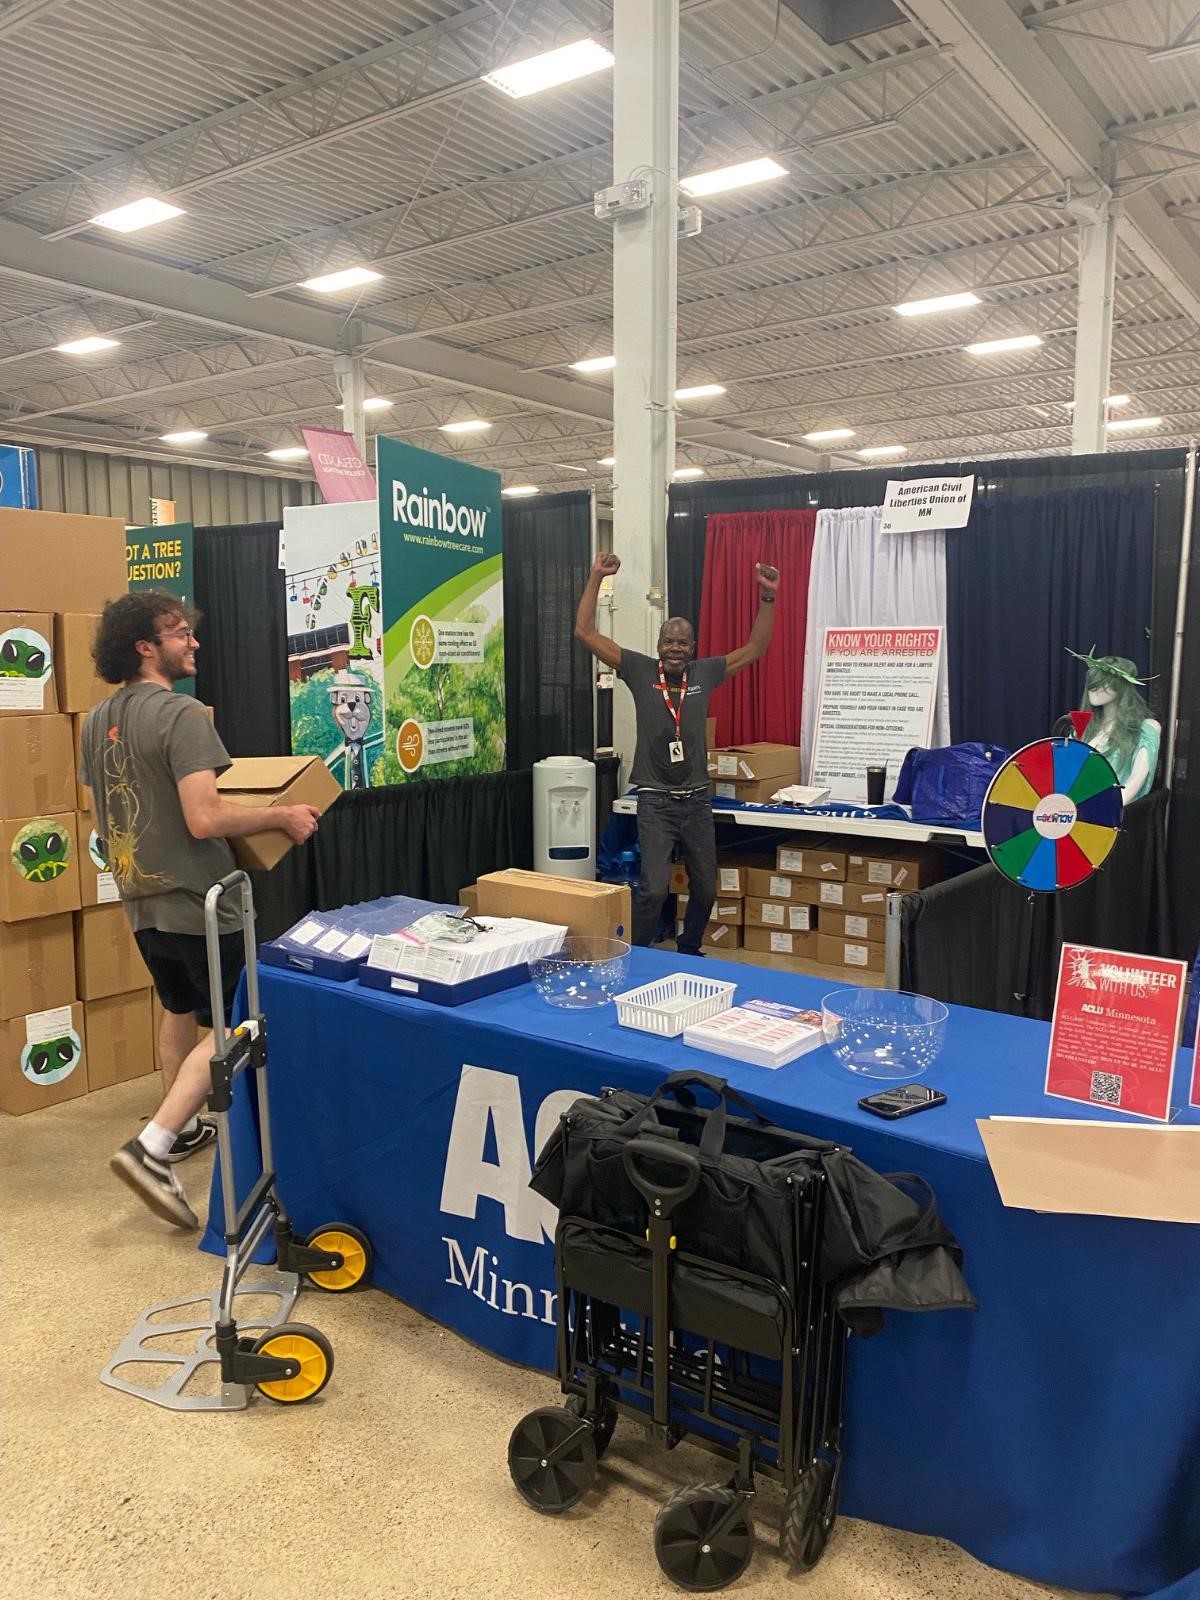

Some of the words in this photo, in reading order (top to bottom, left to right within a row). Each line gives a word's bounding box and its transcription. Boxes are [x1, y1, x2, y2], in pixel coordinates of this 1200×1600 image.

[898, 485, 939, 496] American
[941, 483, 962, 492] Civil
[392, 479, 487, 538] Rainbow
[890, 498, 927, 508] Liberties
[929, 495, 955, 504] Union
[957, 494, 967, 503] of
[918, 507, 932, 517] MN
[125, 544, 140, 562] OT
[141, 543, 151, 560] A
[152, 539, 182, 559] TREE
[403, 532, 484, 554] www.rainbowtreecare.com
[127, 561, 181, 582] UESTION?
[828, 633, 861, 648] KNOW
[863, 632, 892, 647] YOUR
[895, 632, 935, 647] RIGHTS
[827, 649, 837, 657] IF
[838, 649, 857, 657] YOU
[859, 649, 879, 657] ARE
[880, 648, 934, 657] ARRESTED
[1100, 963, 1177, 989] VOLUNTEER
[1099, 978, 1127, 995] WITH
[1081, 1003, 1104, 1015] ACLU
[1105, 1008, 1157, 1025] Minnesota
